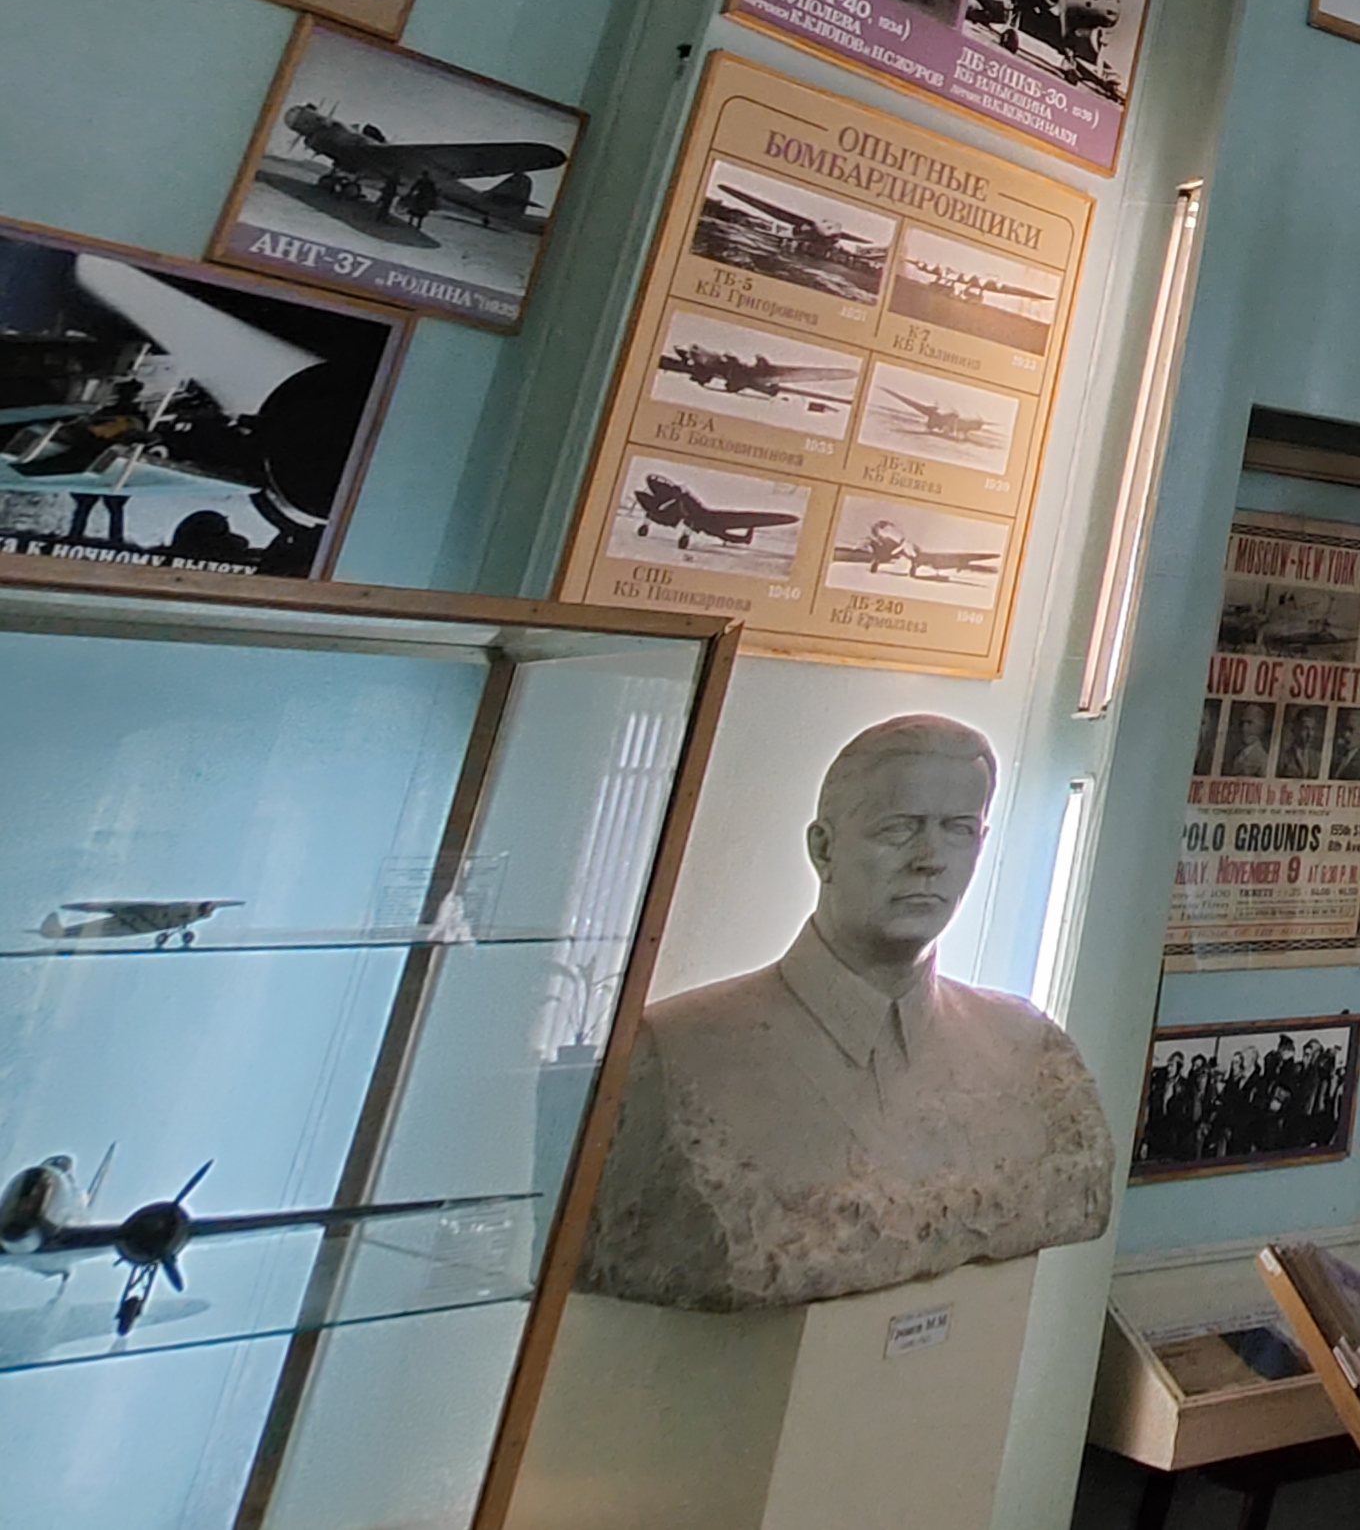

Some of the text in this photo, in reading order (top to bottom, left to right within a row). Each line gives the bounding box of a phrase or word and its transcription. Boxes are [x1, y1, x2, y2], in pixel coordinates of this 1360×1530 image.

[954, 65, 1053, 120] КБ ИЛЬЮШИНА
[838, 125, 990, 202] ОПЫТНЫЕ
[763, 130, 1043, 252] БОМБАРДИРОВЩИКИ
[250, 232, 374, 278] АНТ-37
[712, 267, 754, 292] ТБ-5
[694, 279, 820, 327] КБ Григоровича
[893, 334, 915, 353] КБ
[654, 422, 804, 468] КБ Болховитинова
[862, 466, 886, 485] КБ
[632, 566, 673, 585] СПБ
[1328, 548, 1356, 585] YORK
[612, 580, 753, 612] КБ Поликарпова
[767, 584, 801, 601] 1940
[849, 594, 904, 615] ДБ-240
[830, 606, 853, 625] КБ
[1254, 660, 1284, 698] OF
[1299, 784, 1332, 807] SOVIET
[1234, 823, 1322, 853] GROUNDS
[1286, 855, 1301, 885] 9
